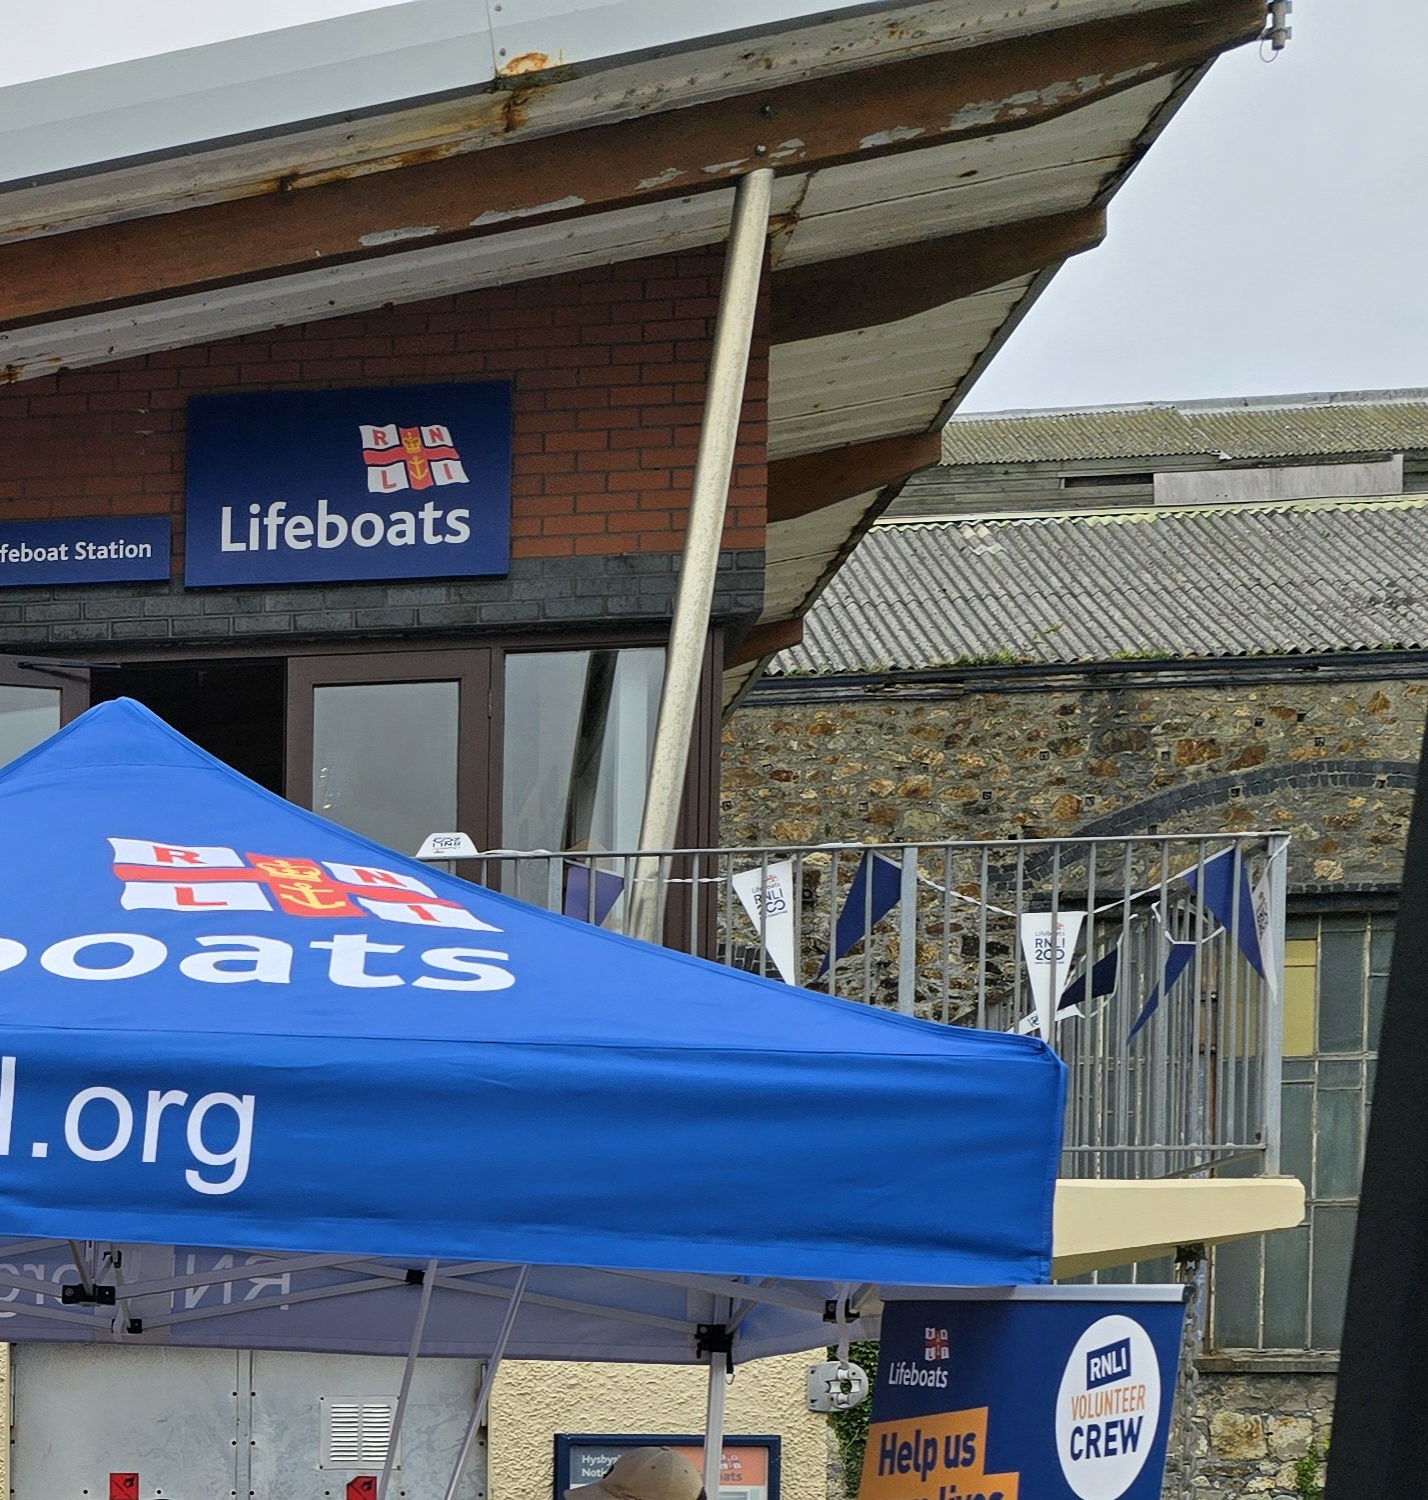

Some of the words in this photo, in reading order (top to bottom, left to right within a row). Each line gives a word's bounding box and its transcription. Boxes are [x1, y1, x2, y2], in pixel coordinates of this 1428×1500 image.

[221, 499, 470, 552] Lifeboats
[75, 538, 152, 560] Station
[889, 1362, 948, 1388] Lifeboats
[1089, 1347, 1127, 1382] RNLI
[1071, 1384, 1146, 1422] VOLUNTEER
[878, 1429, 937, 1482] Help
[943, 1431, 977, 1468] us
[1070, 1416, 1144, 1462] CREW
